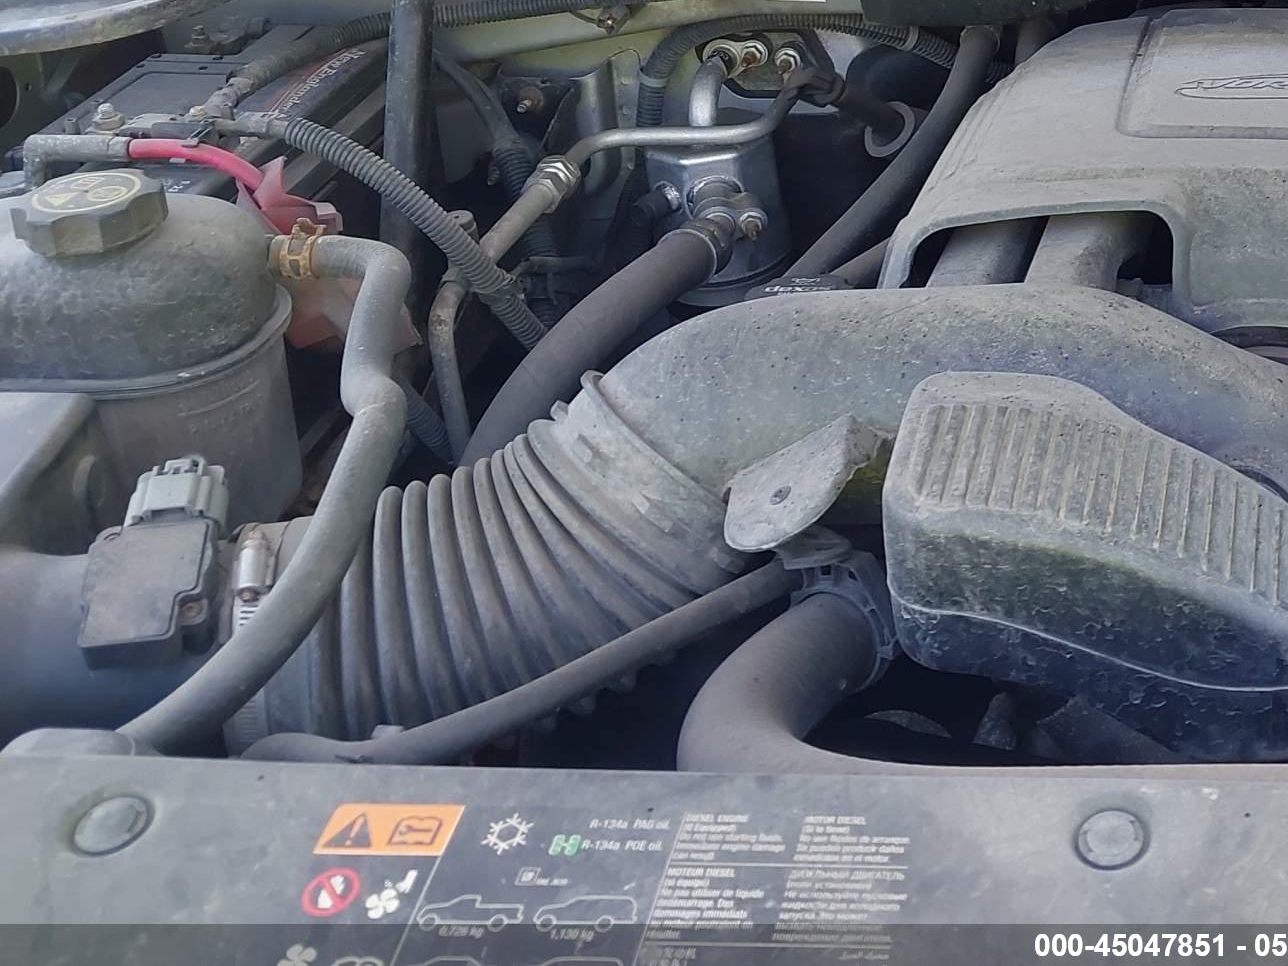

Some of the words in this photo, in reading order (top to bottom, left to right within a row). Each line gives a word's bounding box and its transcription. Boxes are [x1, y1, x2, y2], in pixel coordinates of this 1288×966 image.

[334, 47, 367, 68] New
[589, 817, 629, 830] R-134a
[633, 817, 655, 830] PAG
[686, 813, 714, 823] DIESEL
[581, 839, 621, 851] R-134a
[625, 840, 647, 851] POE
[666, 867, 705, 877] MOTEUR
[704, 868, 736, 878] DIESEL
